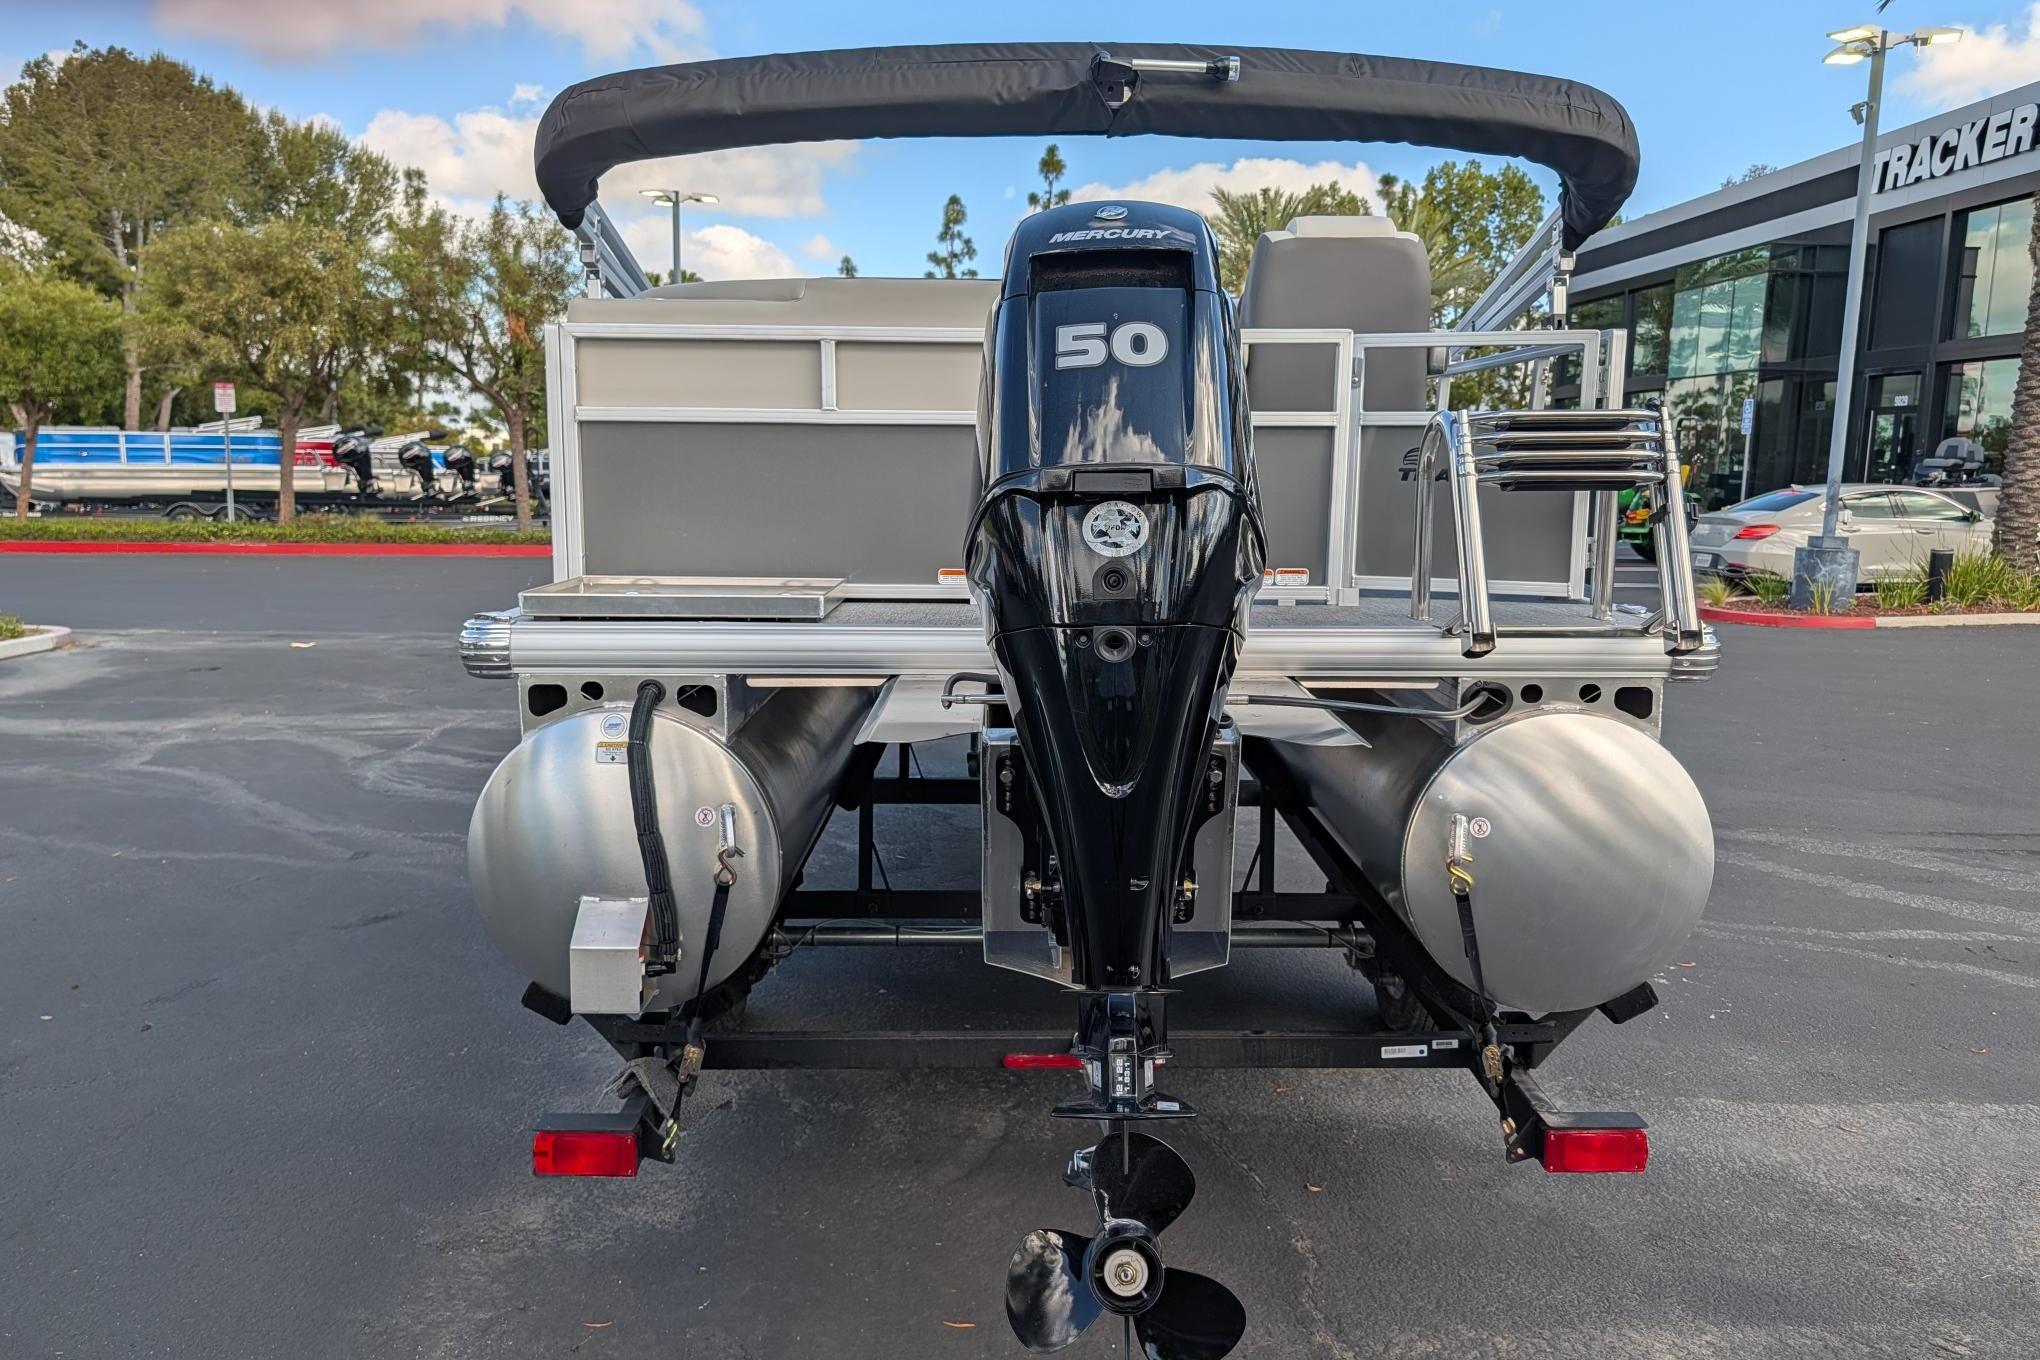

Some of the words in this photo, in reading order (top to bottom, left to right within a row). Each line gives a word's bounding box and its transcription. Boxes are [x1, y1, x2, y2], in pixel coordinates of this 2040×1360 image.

[1871, 103, 2039, 195] TRACKER
[1049, 228, 1172, 244] MERCURY
[1055, 321, 1169, 370] 50
